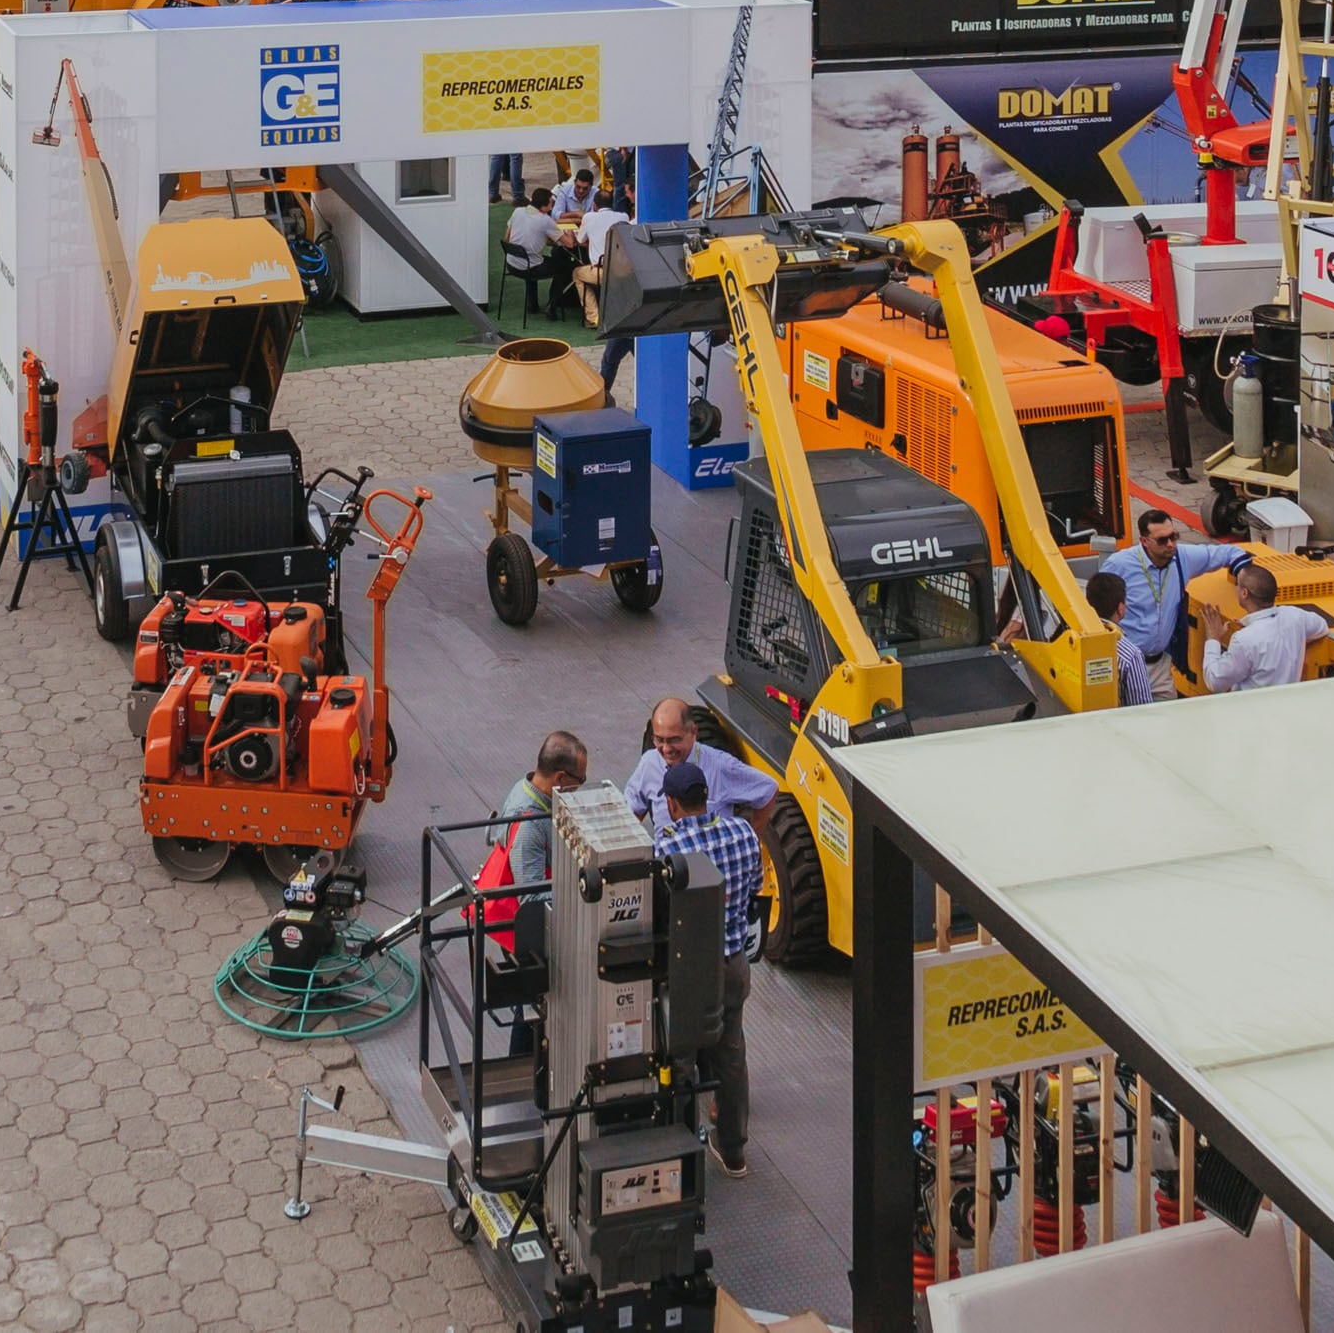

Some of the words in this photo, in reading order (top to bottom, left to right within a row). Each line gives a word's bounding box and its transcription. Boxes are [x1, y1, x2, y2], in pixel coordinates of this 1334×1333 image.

[951, 19, 992, 32] PLANTAS
[1075, 17, 1082, 27] Y
[1085, 13, 1150, 27] MEZCLADORAS
[1150, 12, 1175, 24] PARA
[263, 45, 339, 64] GRUAS
[440, 74, 585, 98] REPRECOMERCIALES
[492, 95, 534, 112] S.A.S.
[998, 85, 1113, 119] DOMAT
[998, 121, 1024, 129] PLANTAS
[1048, 124, 1079, 133] CONCRETO
[261, 128, 340, 146] EQUIPOS
[724, 269, 759, 398] GEHL
[870, 536, 954, 566] GEHL
[607, 894, 643, 910] 30AM
[608, 907, 640, 923] JLG
[1015, 1009, 1068, 1038] S.A.S.
[621, 1174, 648, 1190] JLG
